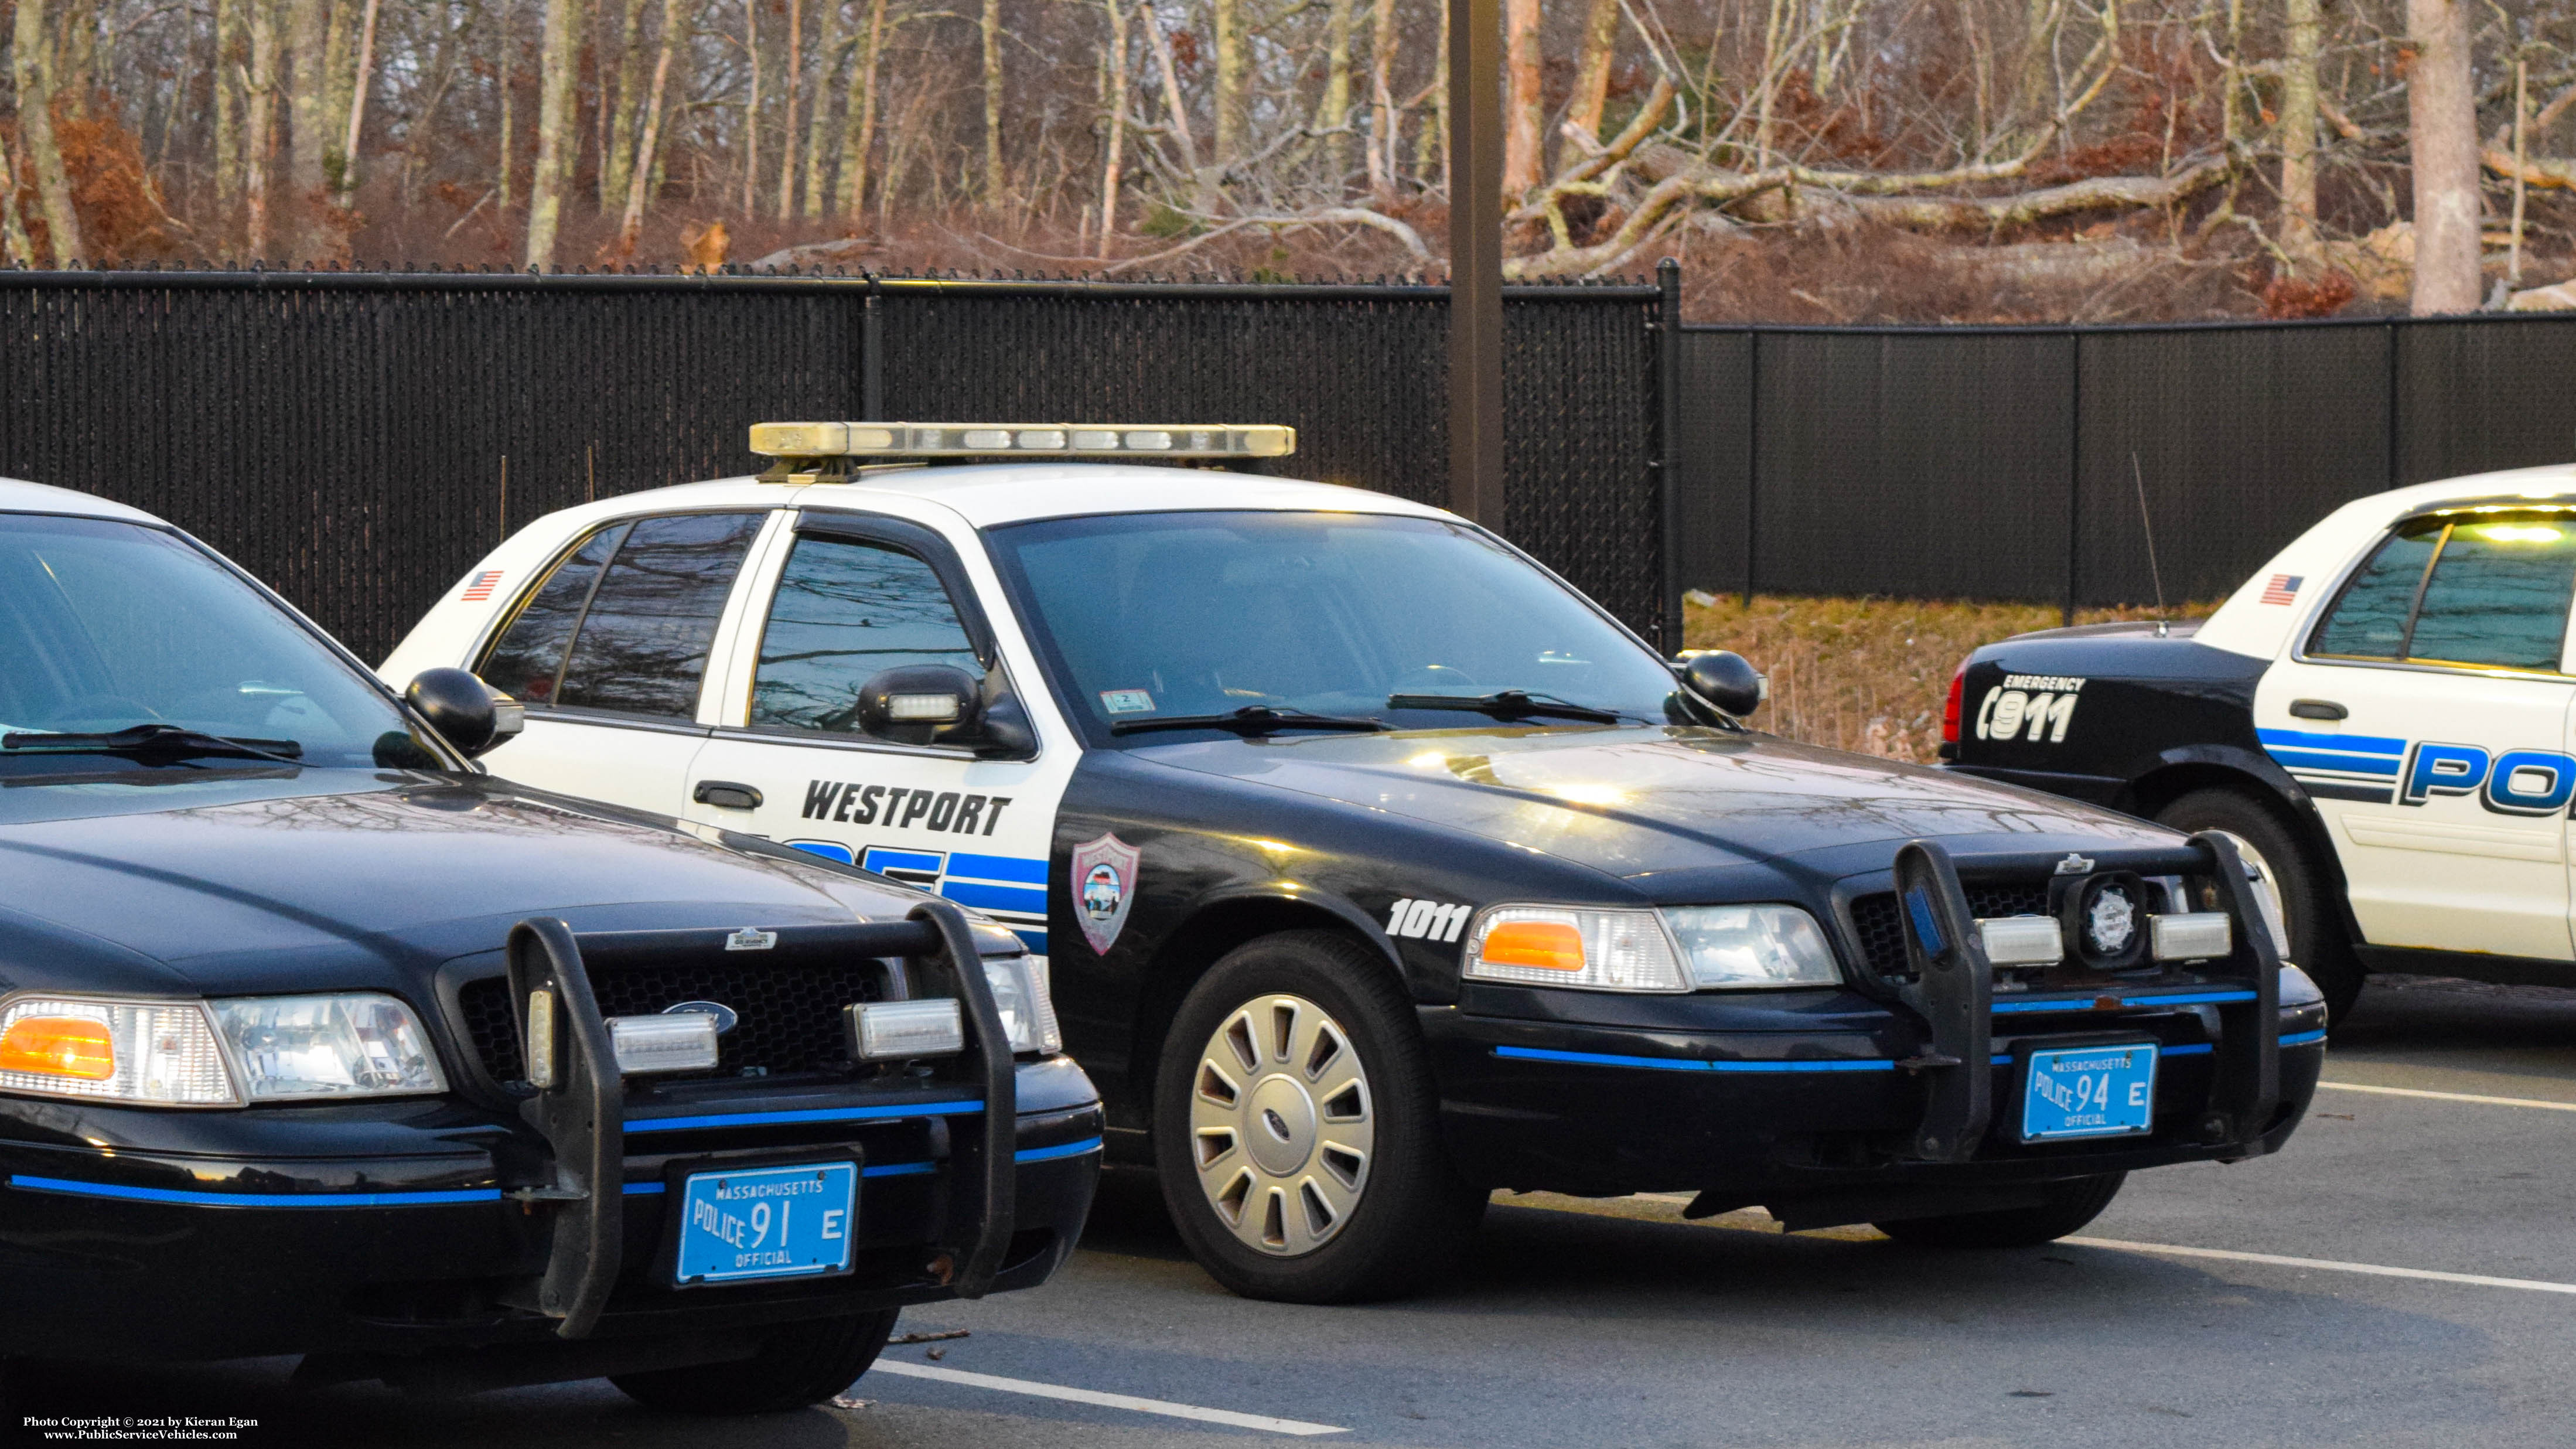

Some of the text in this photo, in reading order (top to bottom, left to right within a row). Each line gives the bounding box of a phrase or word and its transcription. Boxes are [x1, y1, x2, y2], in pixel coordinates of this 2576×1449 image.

[2002, 675, 2086, 691] EMERGENCY
[1990, 690, 2079, 742] 911
[2398, 740, 2576, 820] PO
[801, 779, 1014, 836] WESTPORT
[1385, 898, 1472, 943] 1011
[2052, 1058, 2131, 1073] MASSACHUSETTS
[2034, 1071, 2146, 1112] POLICE 94 E
[2064, 1113, 2107, 1127] OFFICIAL
[715, 1179, 823, 1201] MASSACHUSETTS
[693, 1199, 844, 1249] POLICE 91 E
[735, 1250, 792, 1268] OFFICIAL
